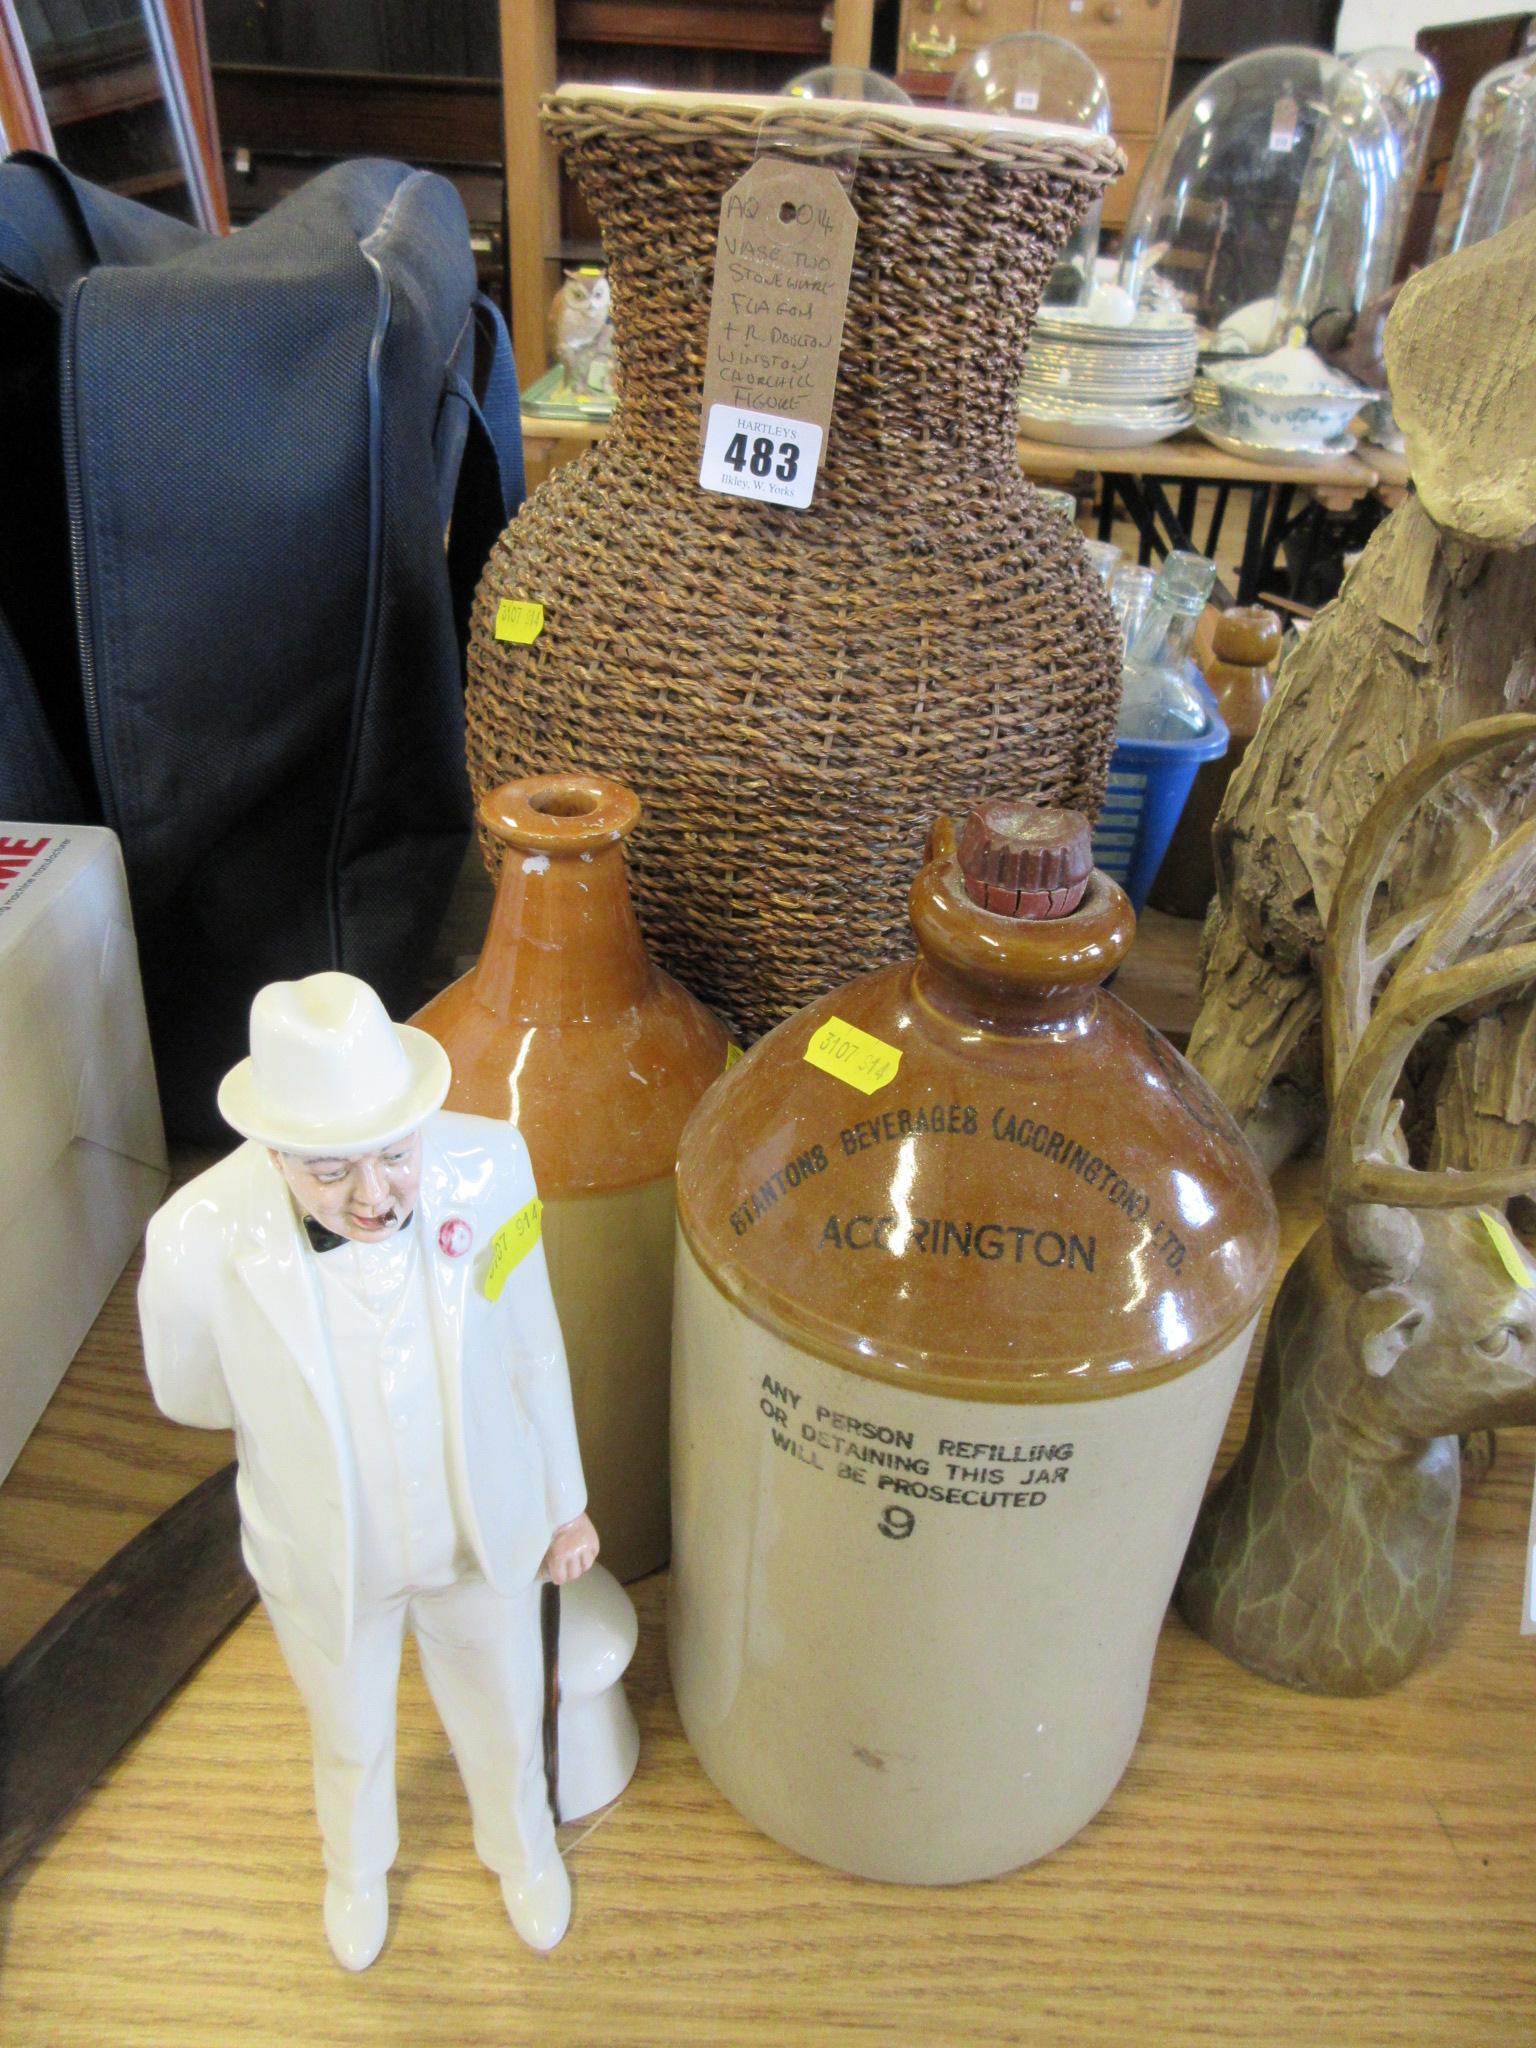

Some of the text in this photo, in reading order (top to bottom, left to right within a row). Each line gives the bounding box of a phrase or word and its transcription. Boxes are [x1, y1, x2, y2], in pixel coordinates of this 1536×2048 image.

[724, 237, 831, 270] VASE TWO
[717, 345, 810, 371] WINSTON
[719, 366, 816, 389] CHURCHILL
[733, 385, 809, 411] FIGURE
[737, 418, 798, 440] HARTLEYS
[723, 433, 800, 483] 483
[721, 474, 796, 498] Ilkley, W. Yorks
[819, 1031, 860, 1063] 3107
[729, 1143, 829, 1237] STANTONS
[839, 1104, 979, 1158] BEVERAGES
[818, 1213, 1097, 1273] ACCRINGTON
[761, 1375, 1074, 1462] ANY PERSON REFILLING
[759, 1398, 1070, 1486] OR DETAINING THIS JAR
[771, 1428, 1047, 1508] WILL BE PROSECUTED
[877, 1504, 916, 1540] 9
